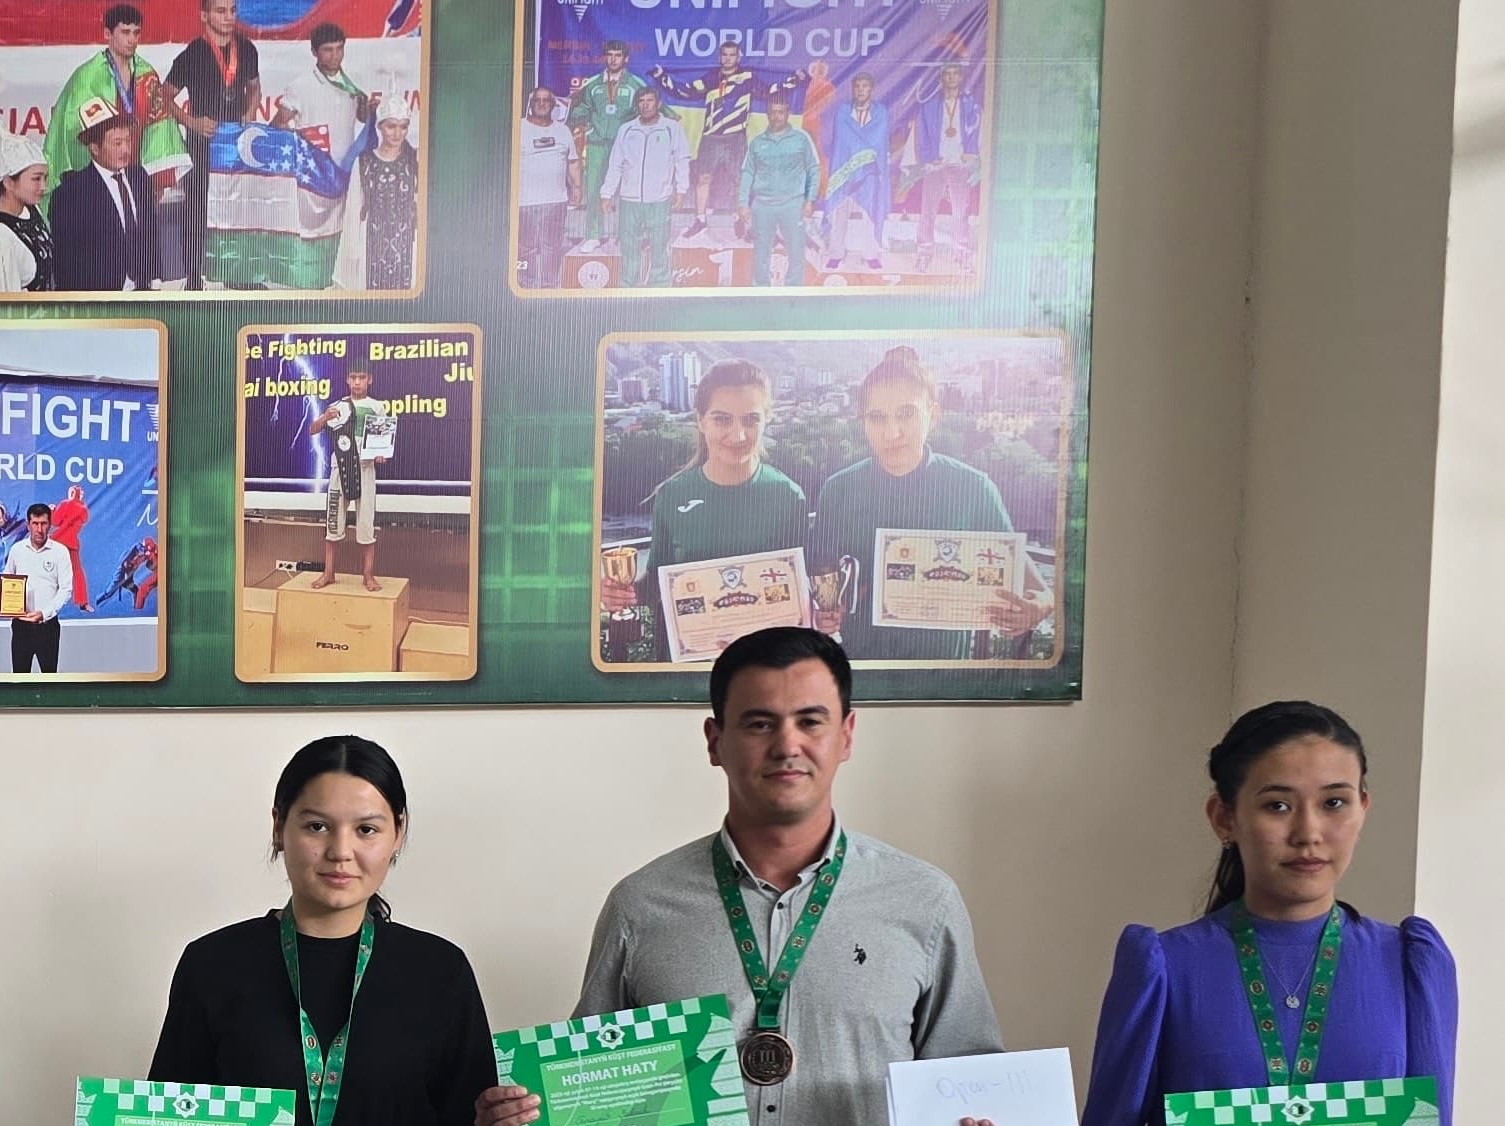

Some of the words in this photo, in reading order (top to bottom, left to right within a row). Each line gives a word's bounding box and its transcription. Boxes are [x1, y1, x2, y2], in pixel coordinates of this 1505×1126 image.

[655, 28, 792, 57] WORLD
[805, 28, 885, 57] CUP
[268, 338, 347, 360] Fighting
[369, 339, 468, 361] Brazilian
[265, 376, 331, 399] boxing
[65, 456, 124, 485] CUP
[316, 641, 349, 650] FERRO
[561, 1067, 620, 1086] HORMAT
[621, 1060, 658, 1076] HATY
